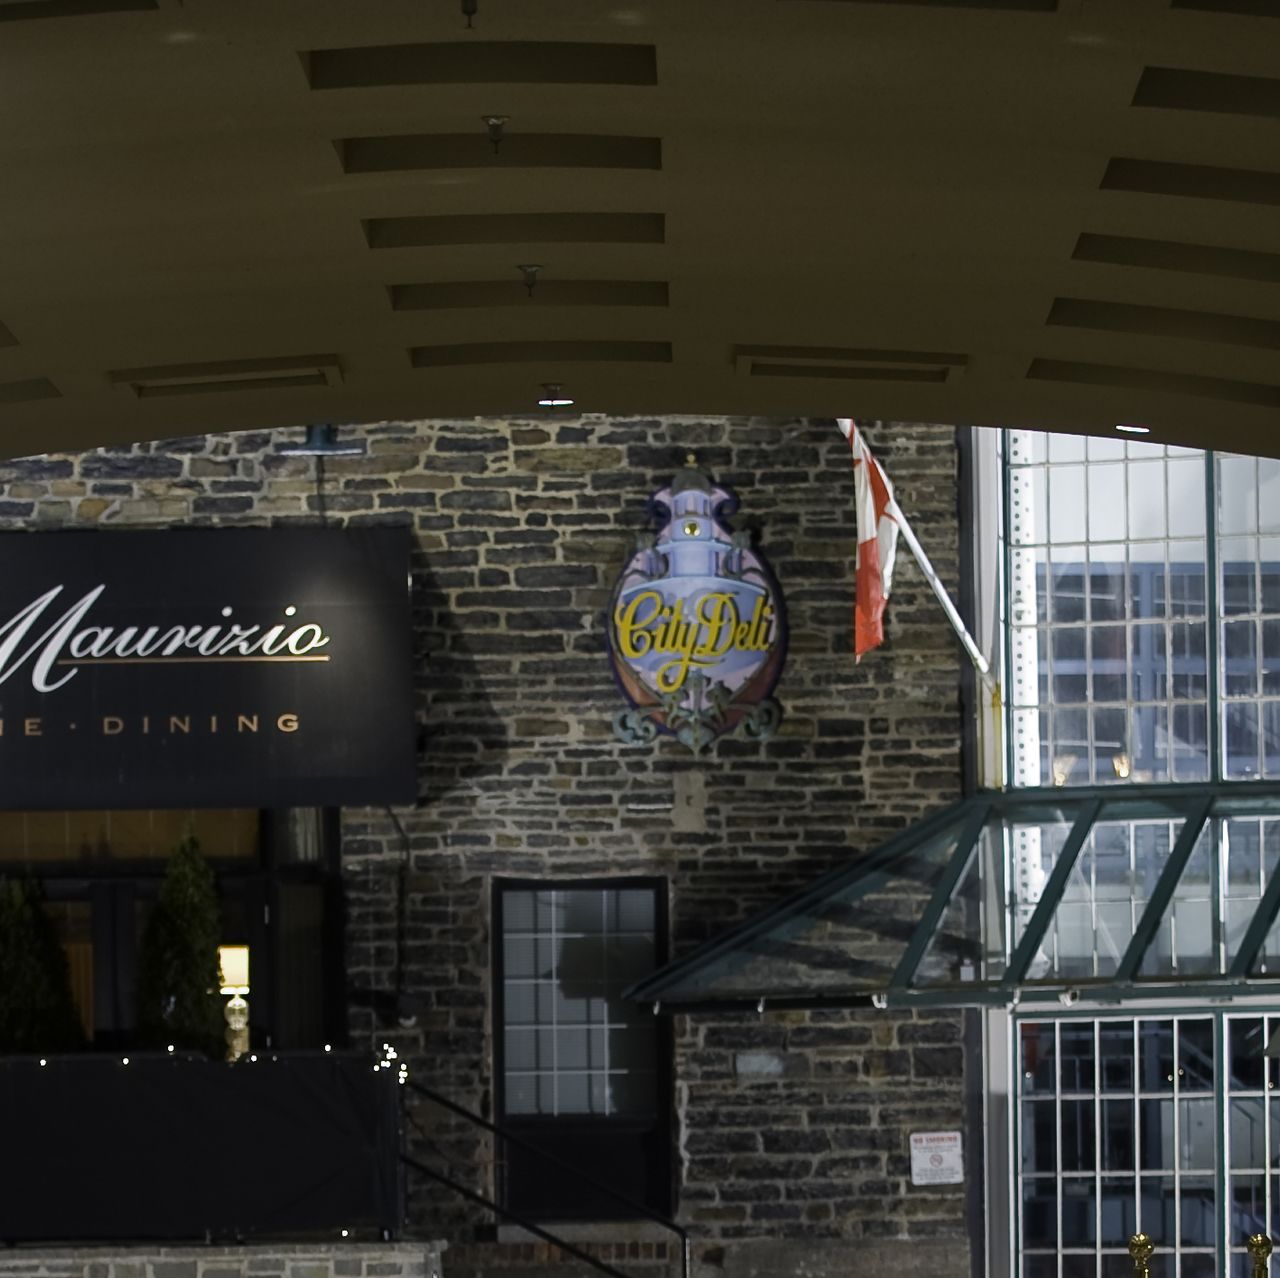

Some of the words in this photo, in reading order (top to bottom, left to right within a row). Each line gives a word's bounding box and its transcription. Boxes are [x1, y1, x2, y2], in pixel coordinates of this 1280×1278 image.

[614, 591, 724, 693] City
[695, 591, 773, 657] Deli
[103, 713, 300, 736] DINING
